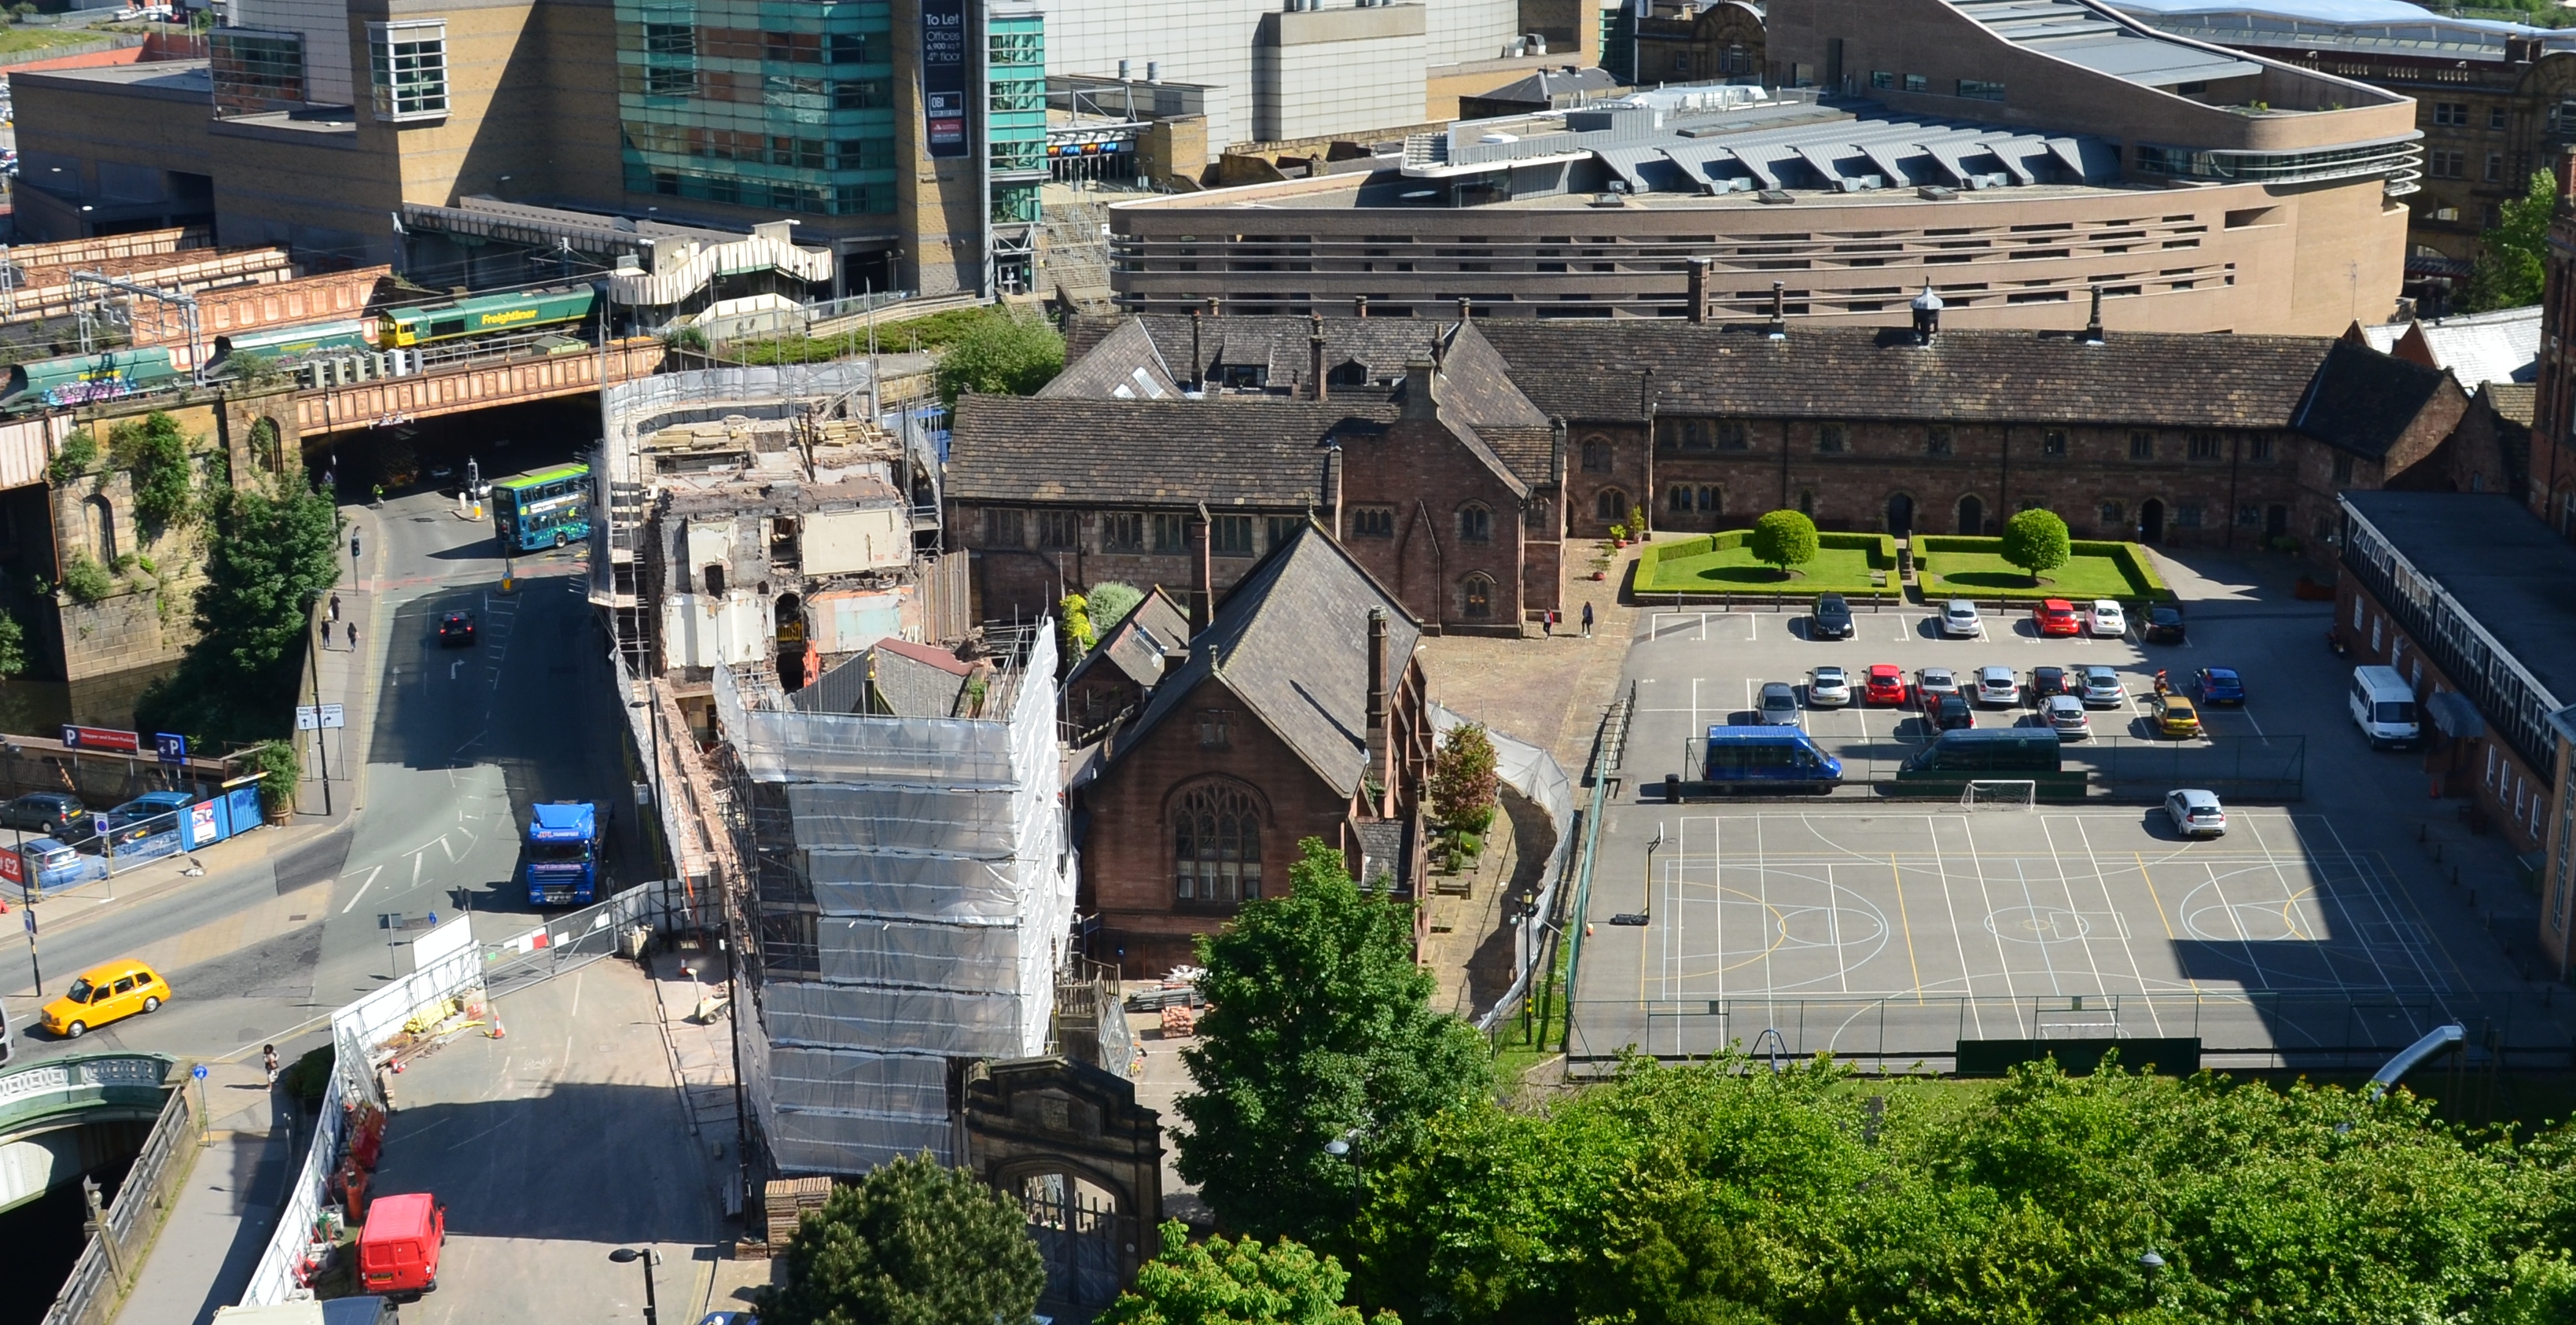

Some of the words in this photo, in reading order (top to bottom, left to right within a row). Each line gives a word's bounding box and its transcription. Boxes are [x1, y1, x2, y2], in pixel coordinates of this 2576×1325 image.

[926, 13, 940, 25] To
[942, 13, 959, 25] Let
[926, 31, 960, 42] Offices
[940, 51, 961, 61] floor
[931, 97, 944, 108] OBI
[481, 310, 537, 325] Freightliner
[66, 729, 76, 745] P
[169, 739, 179, 756] P
[205, 808, 213, 820] P
[5, 857, 19, 876] £2
